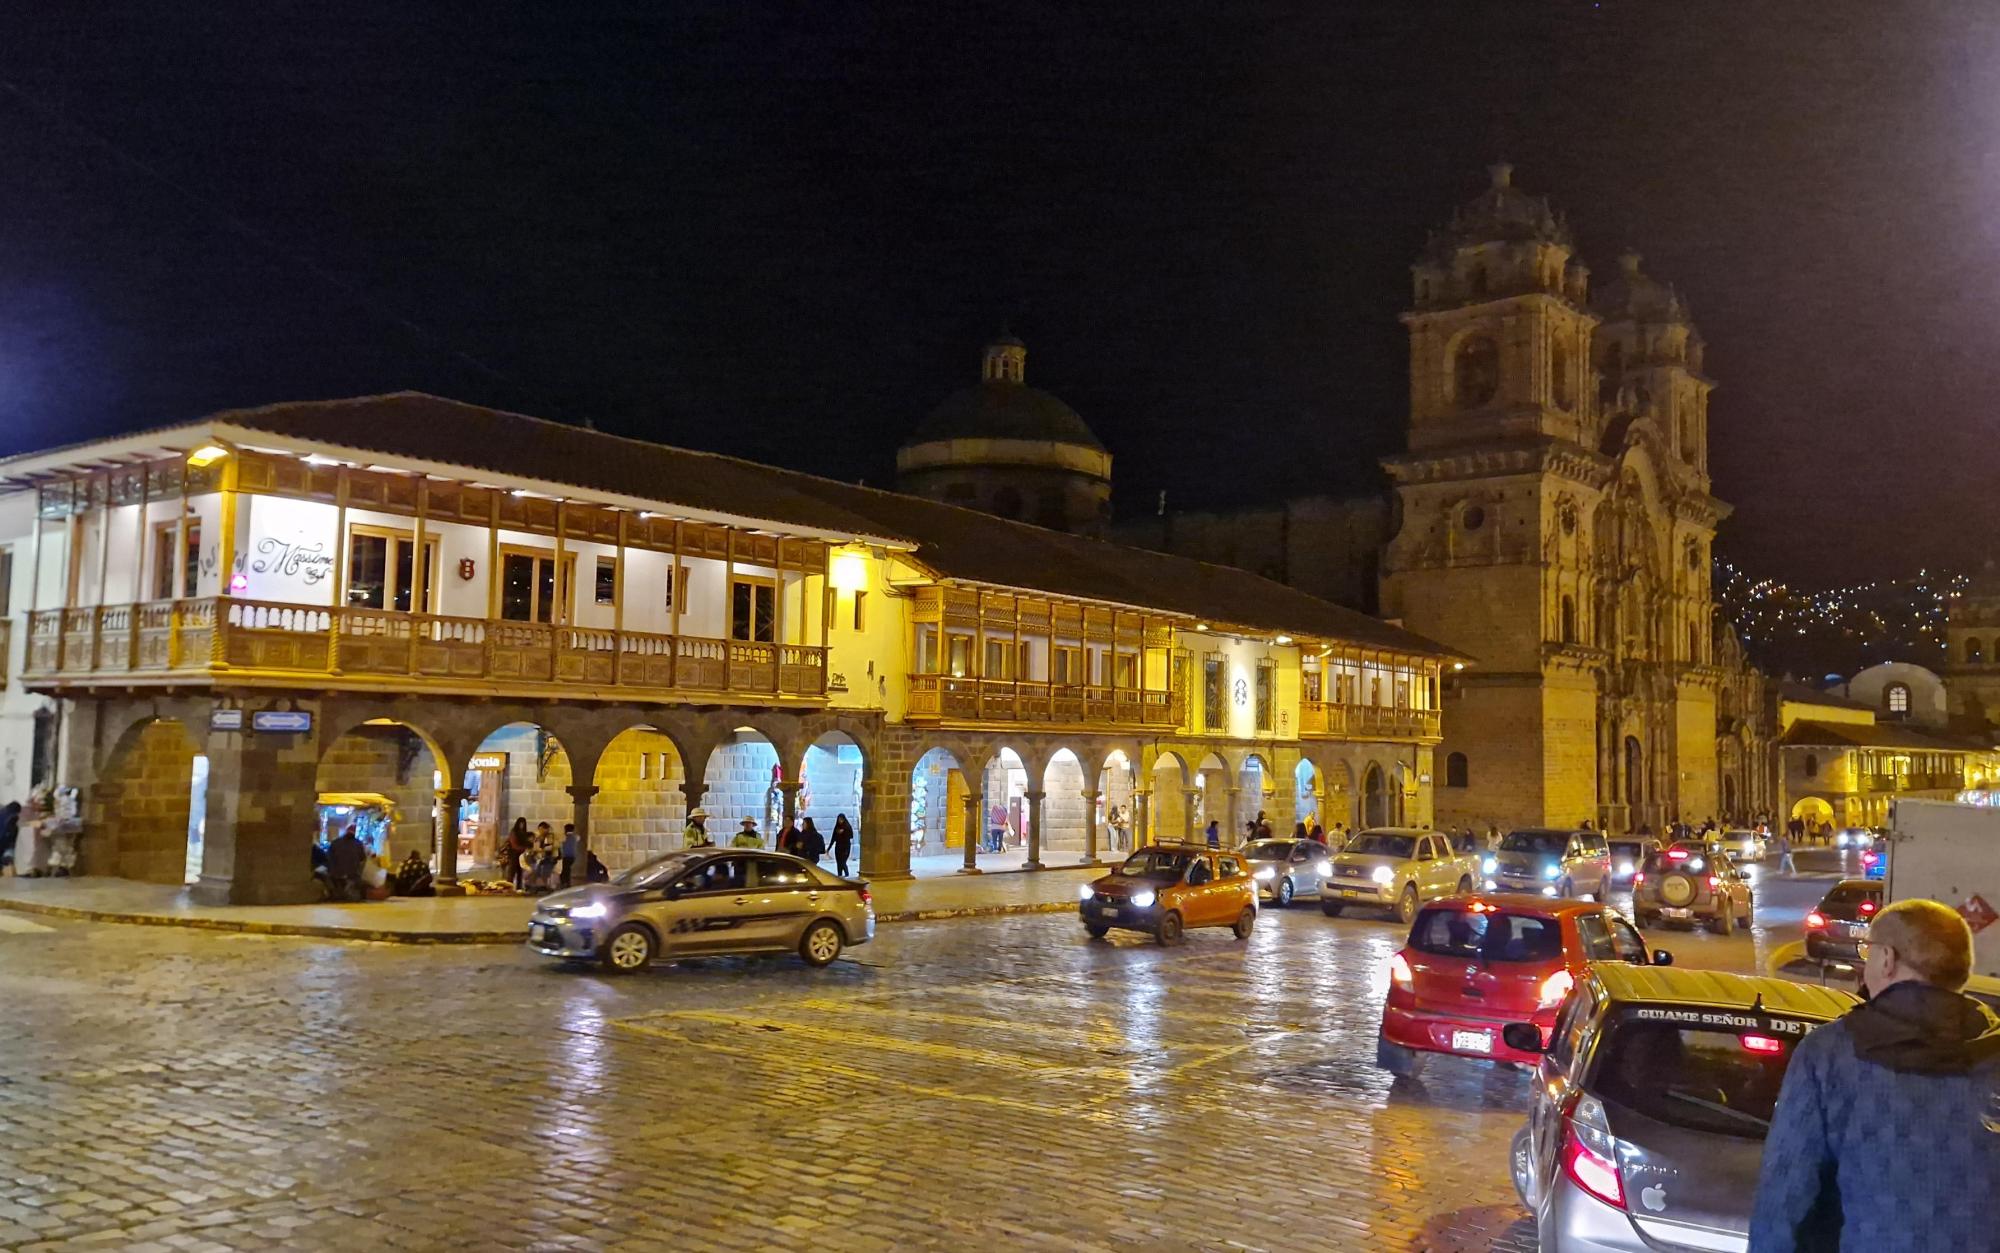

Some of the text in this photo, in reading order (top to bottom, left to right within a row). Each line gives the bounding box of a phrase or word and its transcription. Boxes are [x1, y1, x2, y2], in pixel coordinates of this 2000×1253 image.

[1637, 1008, 1700, 1023] GUIAME
[1702, 1013, 1759, 1029] SEÑOR
[1770, 1018, 1801, 1034] DE
